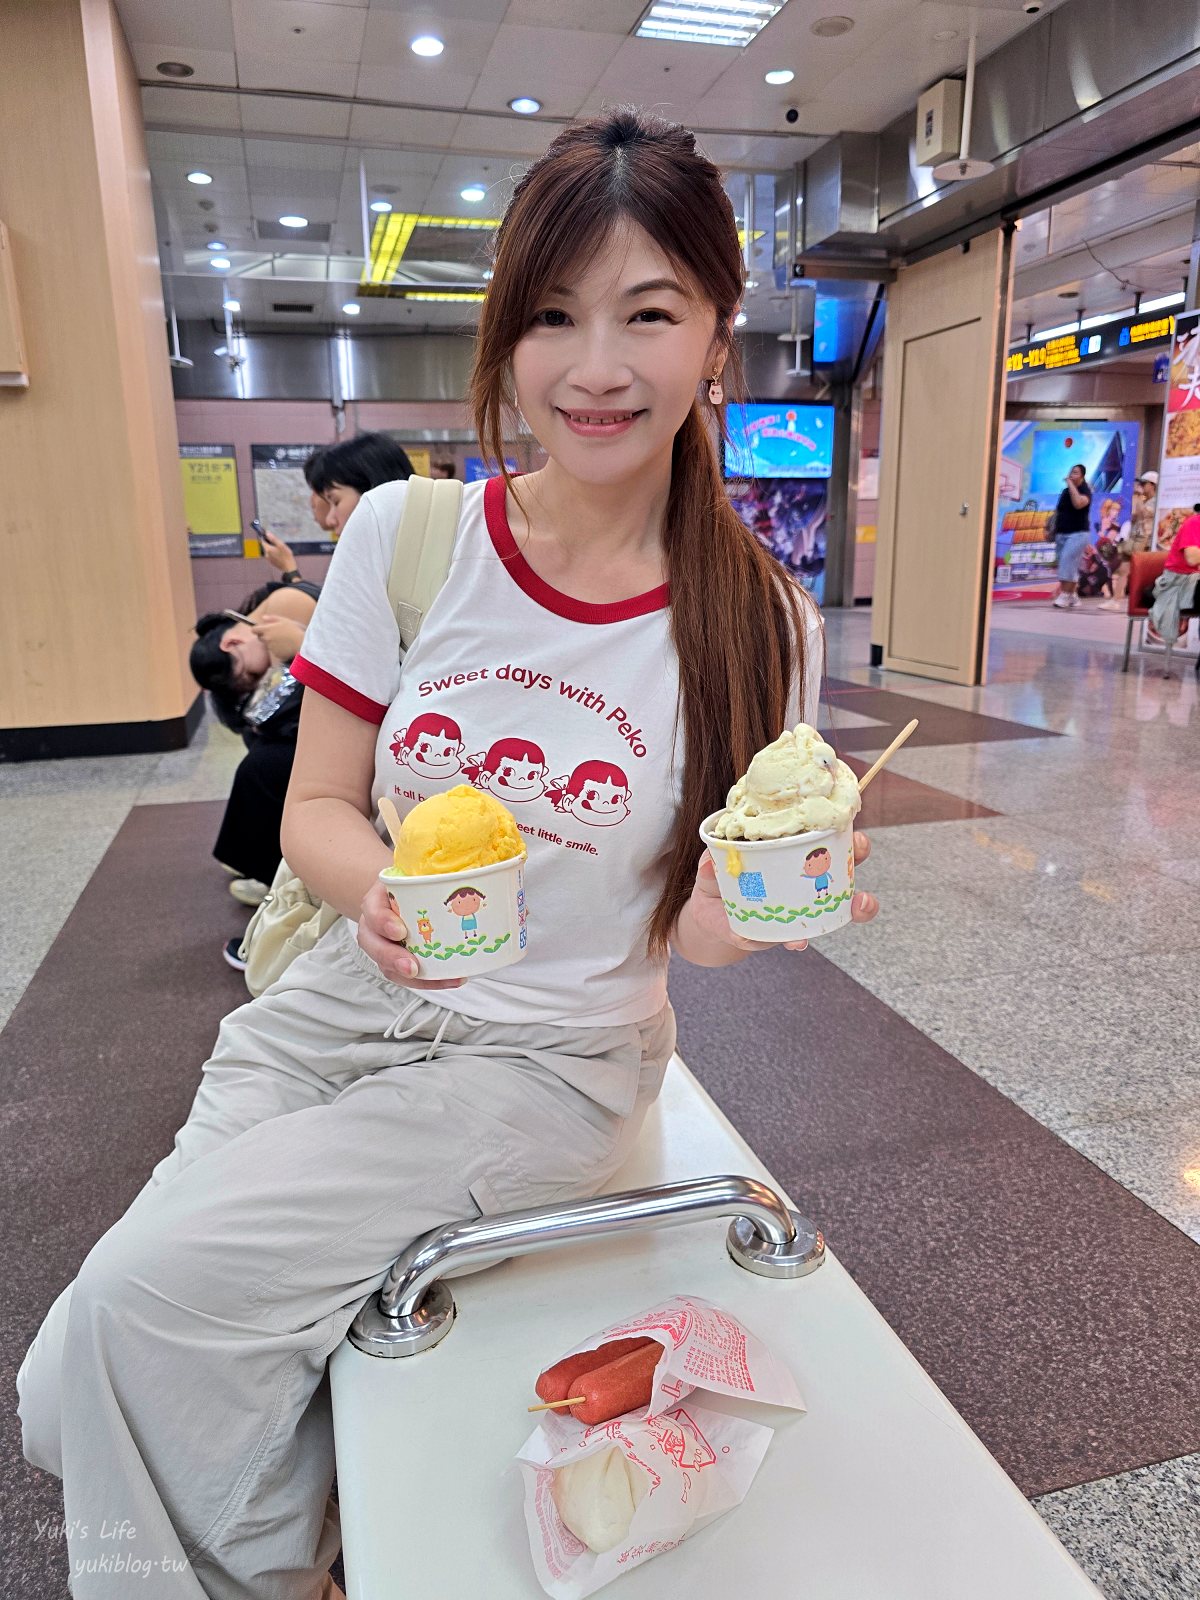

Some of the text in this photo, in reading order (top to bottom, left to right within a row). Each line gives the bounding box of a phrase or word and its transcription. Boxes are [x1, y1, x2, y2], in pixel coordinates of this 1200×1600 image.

[418, 663, 647, 759] Sweet days with Peko
[394, 784, 402, 796] It
[403, 790, 416, 801] all
[537, 828, 563, 846] little
[565, 840, 599, 856] smile.
